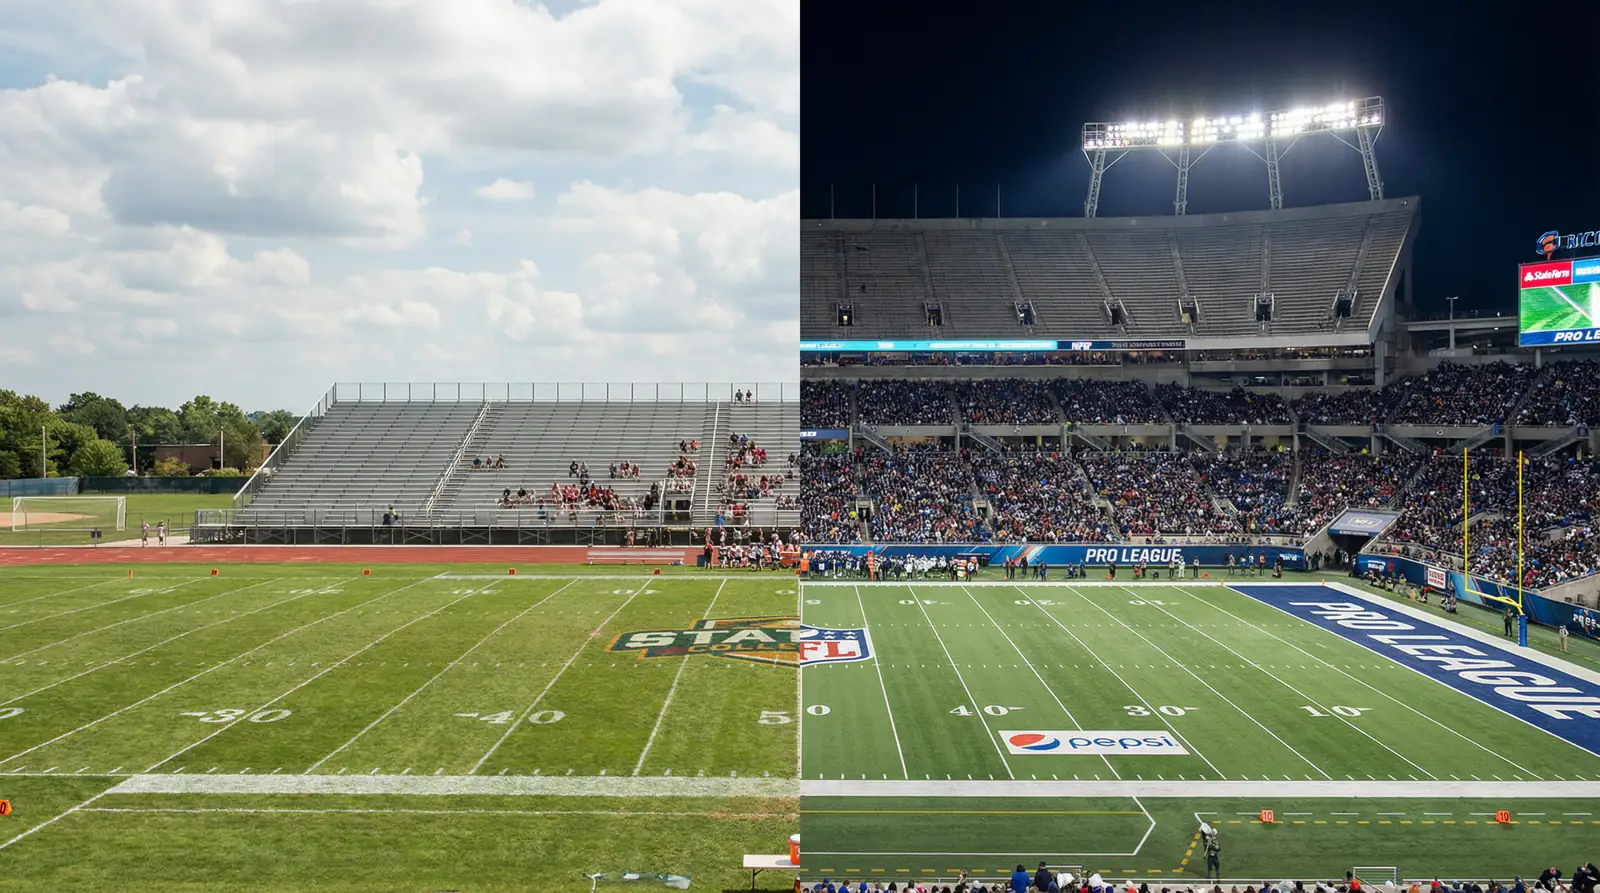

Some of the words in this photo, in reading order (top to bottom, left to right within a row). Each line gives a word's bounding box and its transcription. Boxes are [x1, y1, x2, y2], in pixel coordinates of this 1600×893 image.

[1554, 331, 1583, 342] PRO
[1085, 549, 1118, 562] PRO
[1121, 549, 1181, 562] LEAGUE
[1289, 601, 1416, 631] PRO
[1068, 736, 1174, 750] pepsi
[1263, 811, 1273, 821] 10
[1500, 811, 1509, 822] 10
